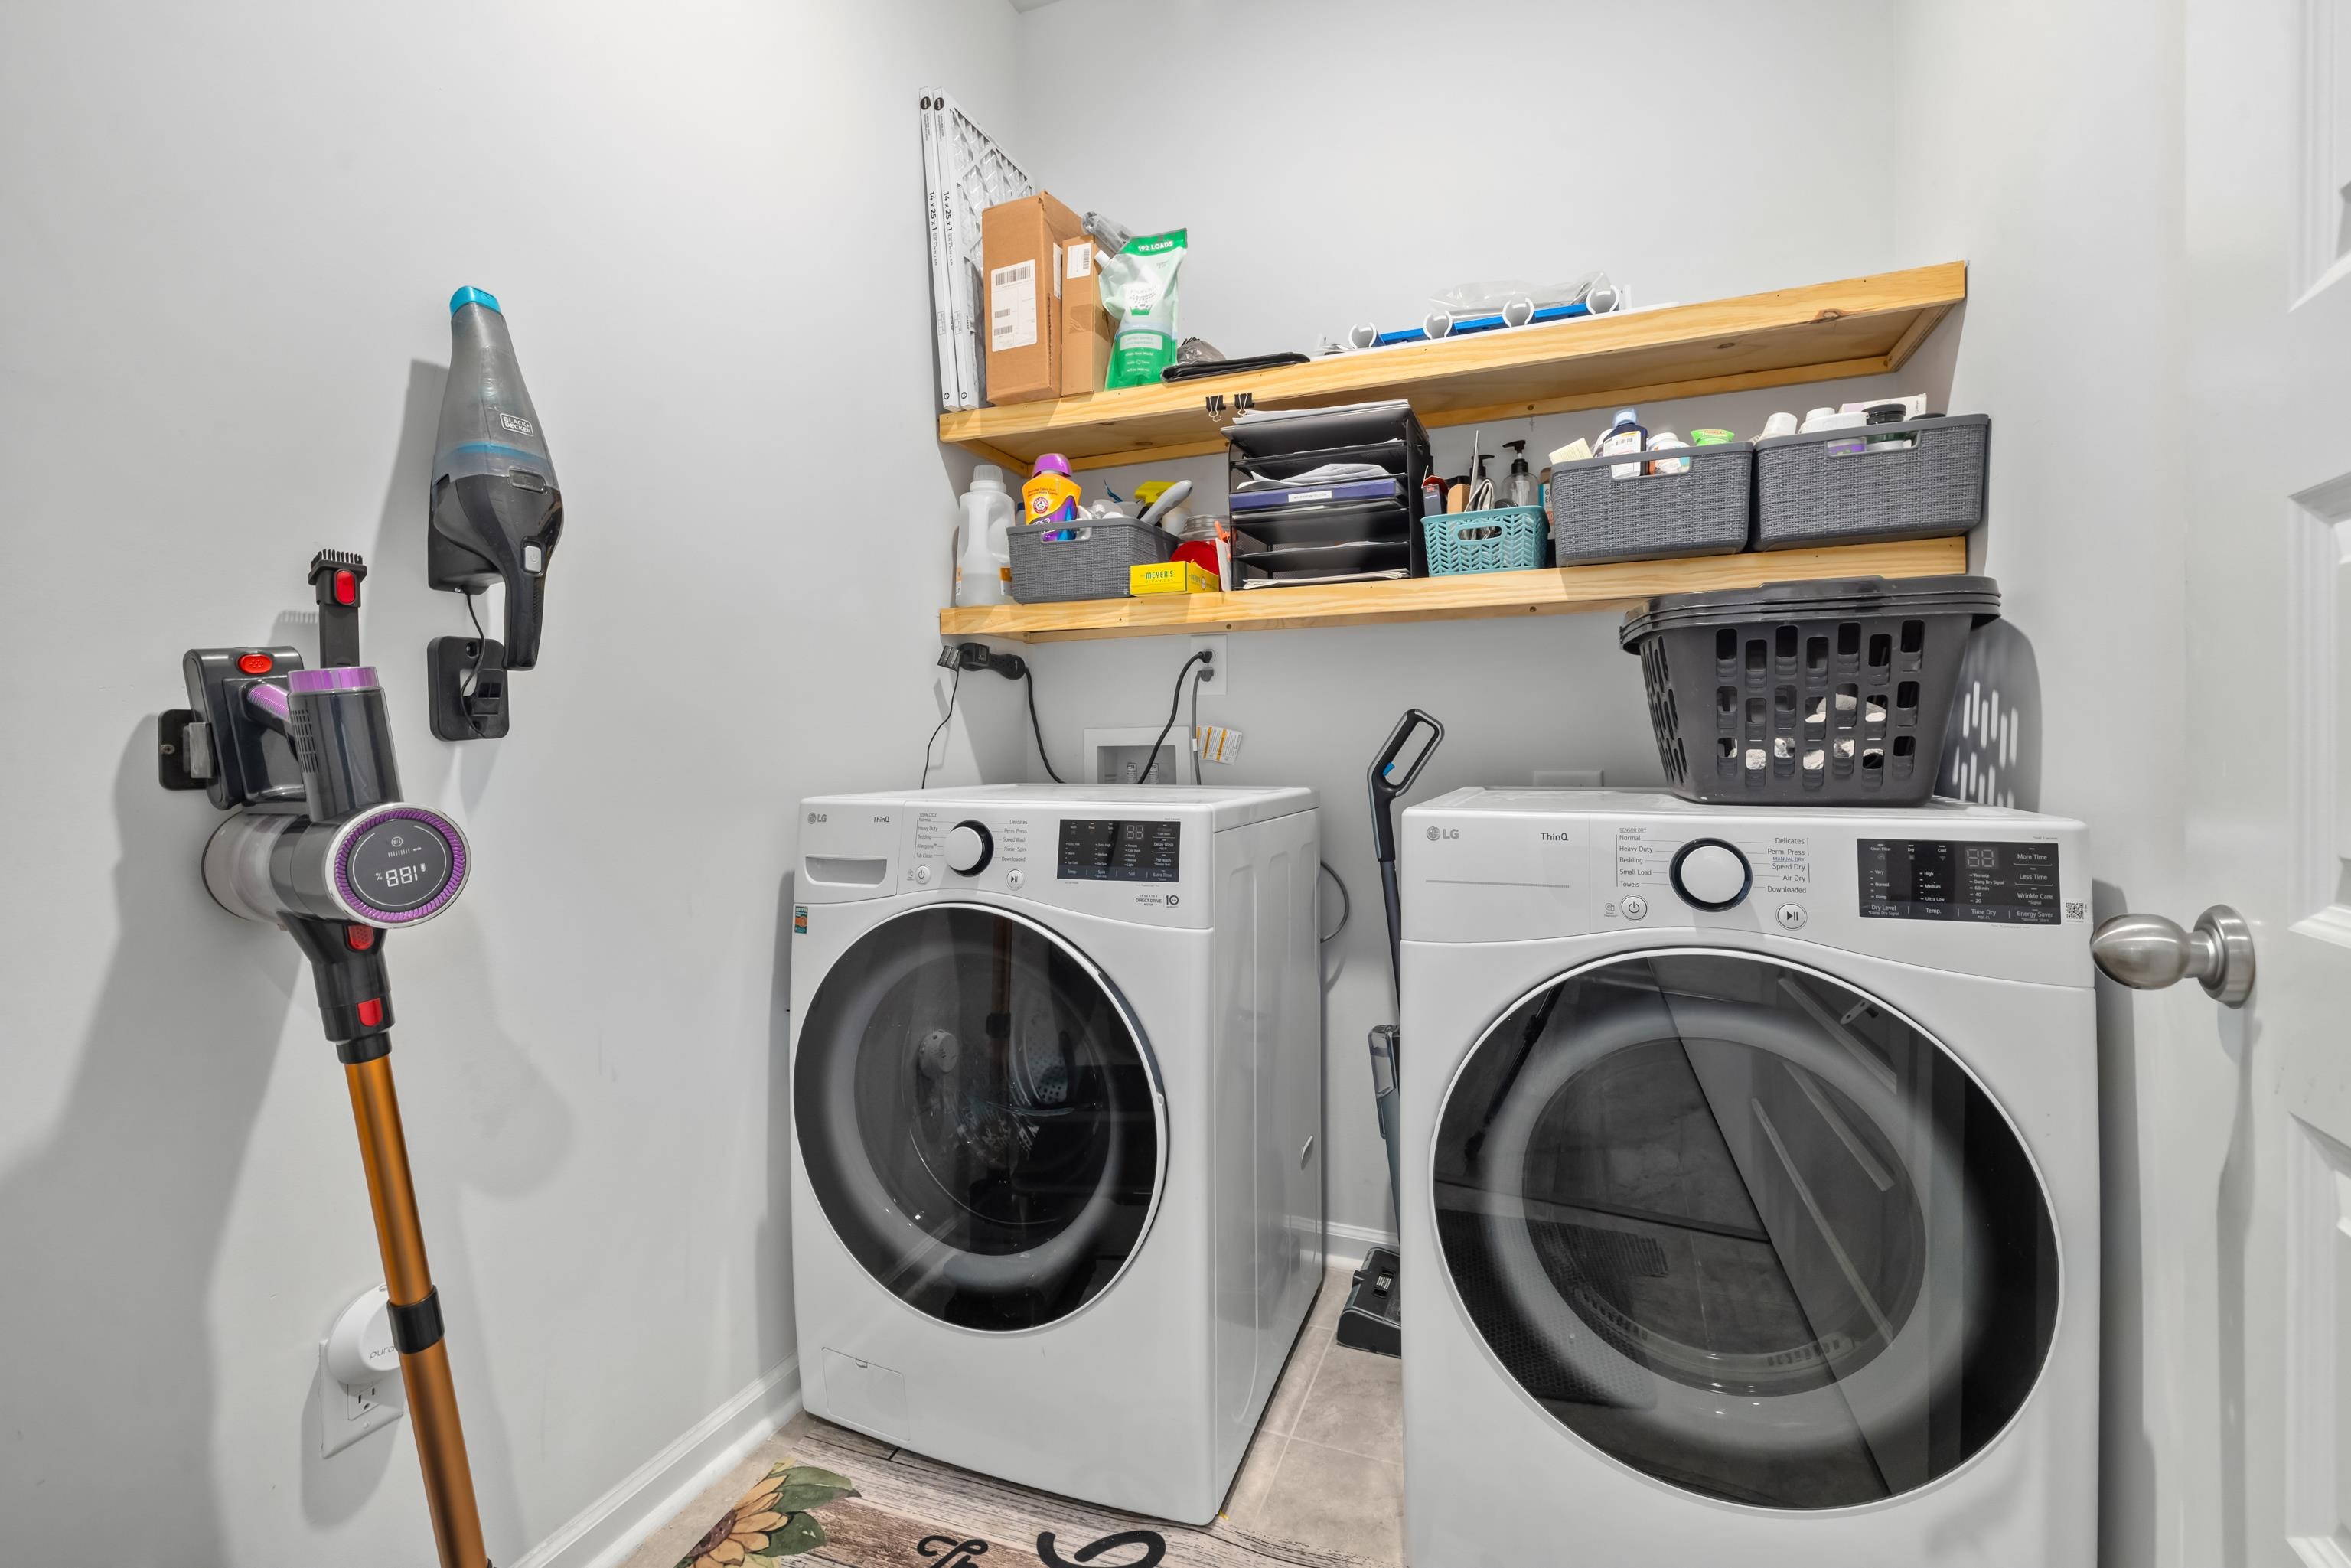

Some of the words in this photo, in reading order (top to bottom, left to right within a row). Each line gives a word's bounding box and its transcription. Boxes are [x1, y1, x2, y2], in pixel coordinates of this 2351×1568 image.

[930, 191, 934, 201] 14
[944, 191, 949, 201] 14
[931, 209, 937, 220] 25
[945, 209, 951, 220] 25
[1151, 240, 1173, 250] LOADS
[504, 422, 531, 433] DECKER
[1146, 570, 1173, 579] MEYER'S
[817, 814, 827, 823] LG
[1127, 826, 1143, 839] 88
[1443, 829, 1459, 839] LG
[1540, 833, 1569, 841] ThinQ
[1967, 849, 1994, 867] 88
[1772, 863, 1792, 872] Speed
[1794, 863, 1805, 872] Dry
[1767, 885, 1807, 894] Downloaded
[1166, 895, 1179, 905] 10
[369, 1345, 396, 1360] pura
